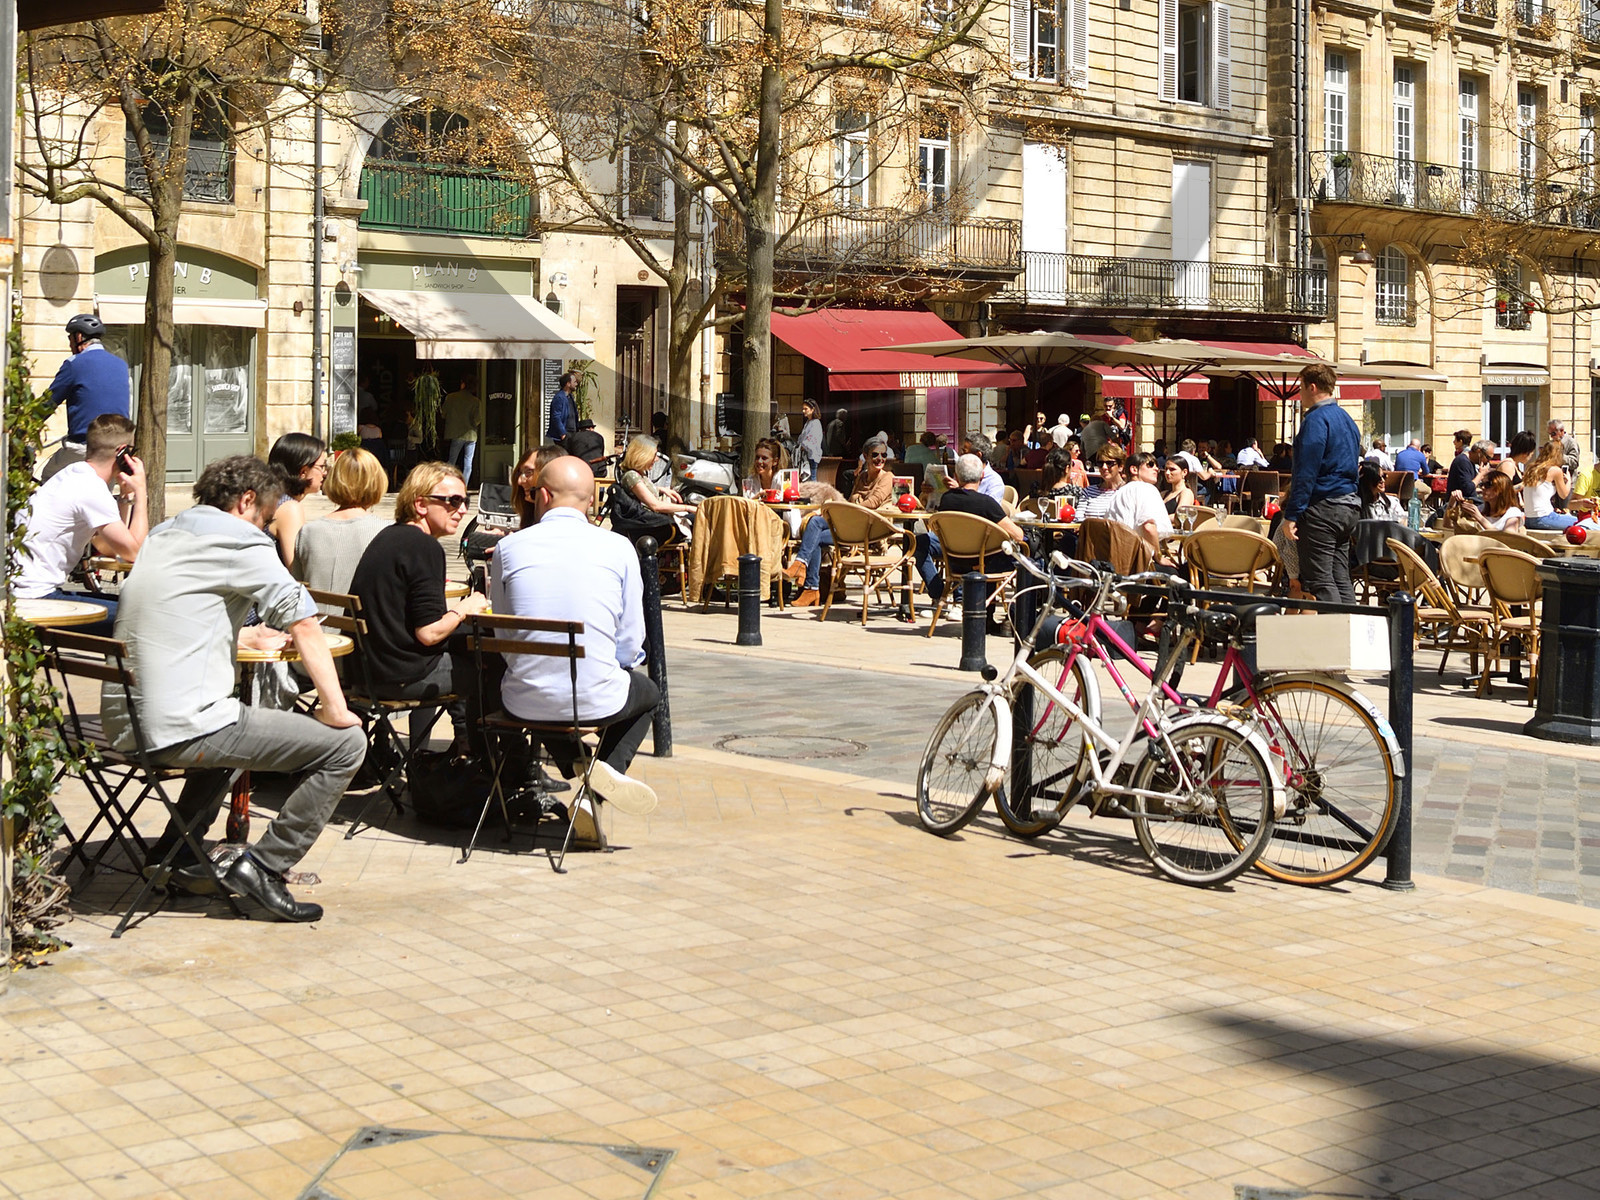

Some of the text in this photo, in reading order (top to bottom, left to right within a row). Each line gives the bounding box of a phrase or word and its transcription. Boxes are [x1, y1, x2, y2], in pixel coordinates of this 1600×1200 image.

[128, 261, 212, 285] PLN B
[412, 261, 478, 282] PLAN B
[899, 371, 910, 388] LES
